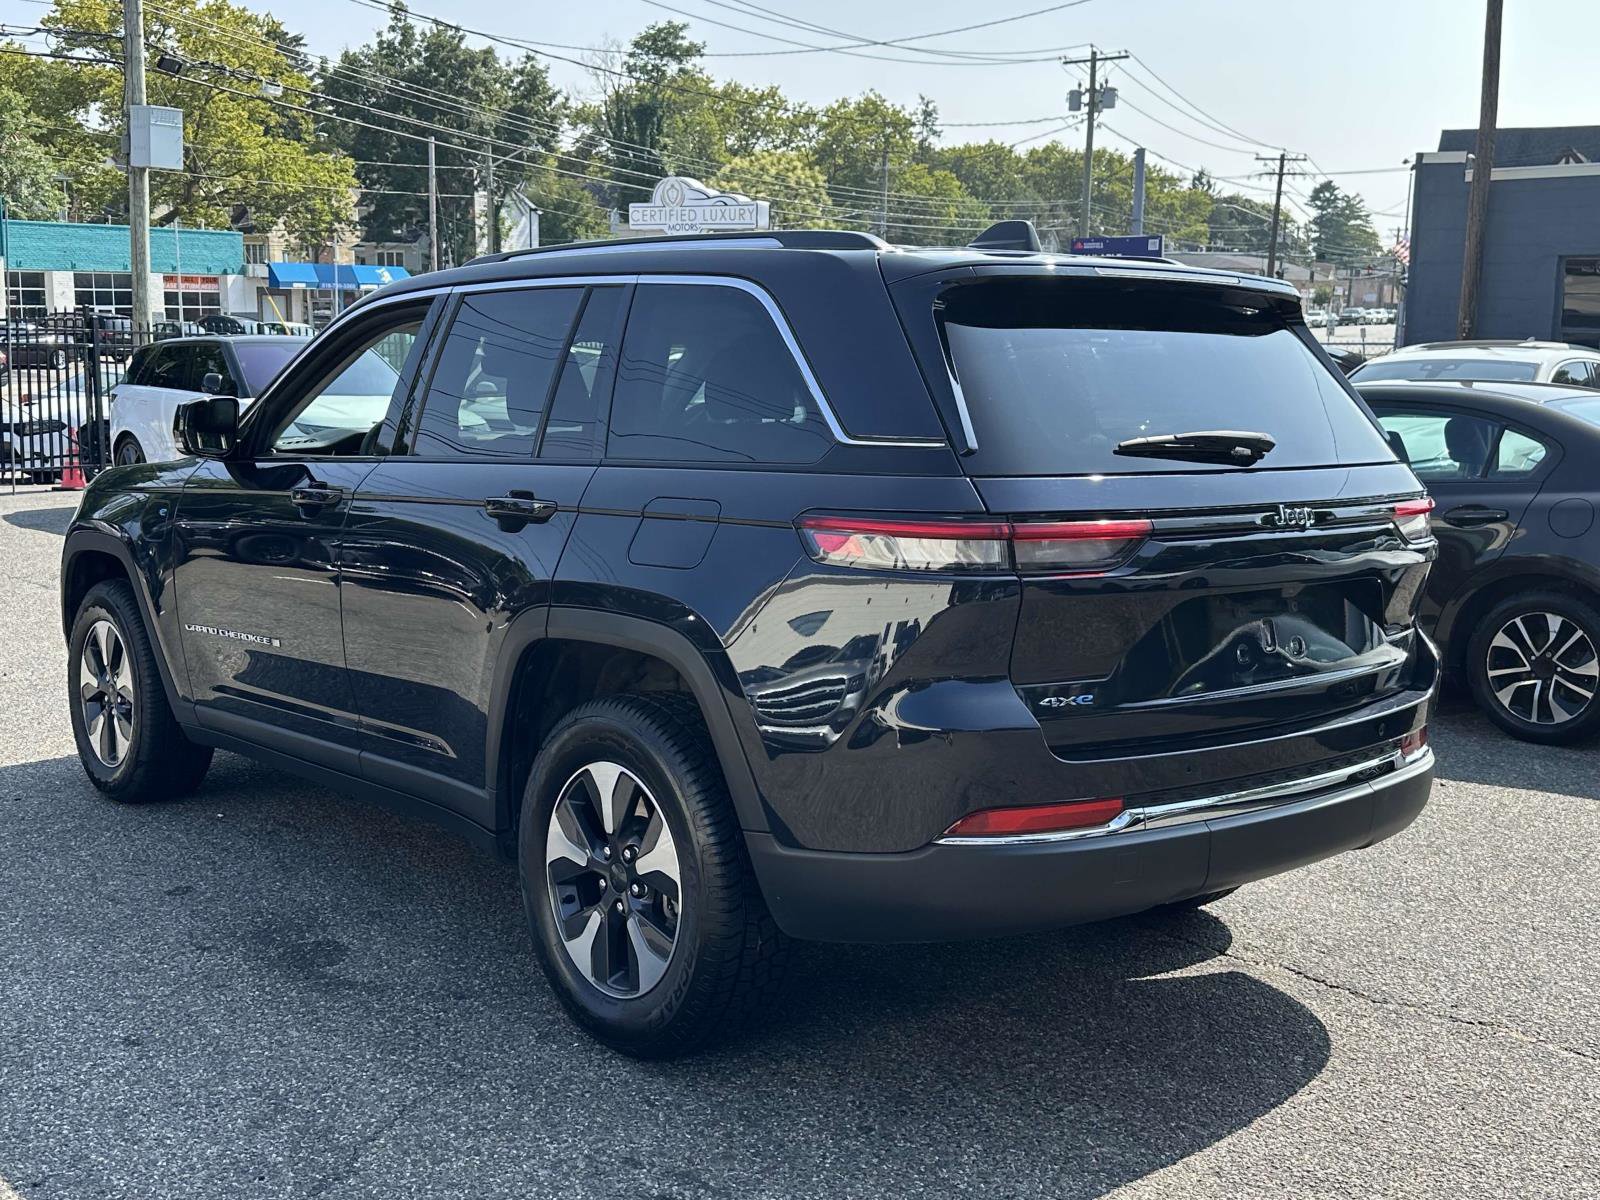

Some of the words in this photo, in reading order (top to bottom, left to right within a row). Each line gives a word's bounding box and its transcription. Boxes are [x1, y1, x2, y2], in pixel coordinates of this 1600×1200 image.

[630, 208, 697, 222] CERTIFIED
[702, 208, 755, 222] LUXURY
[668, 223, 699, 233] MOTORS
[1274, 504, 1315, 529] Jeep
[185, 623, 218, 635] GRAND
[219, 629, 272, 646] CHEROKEE
